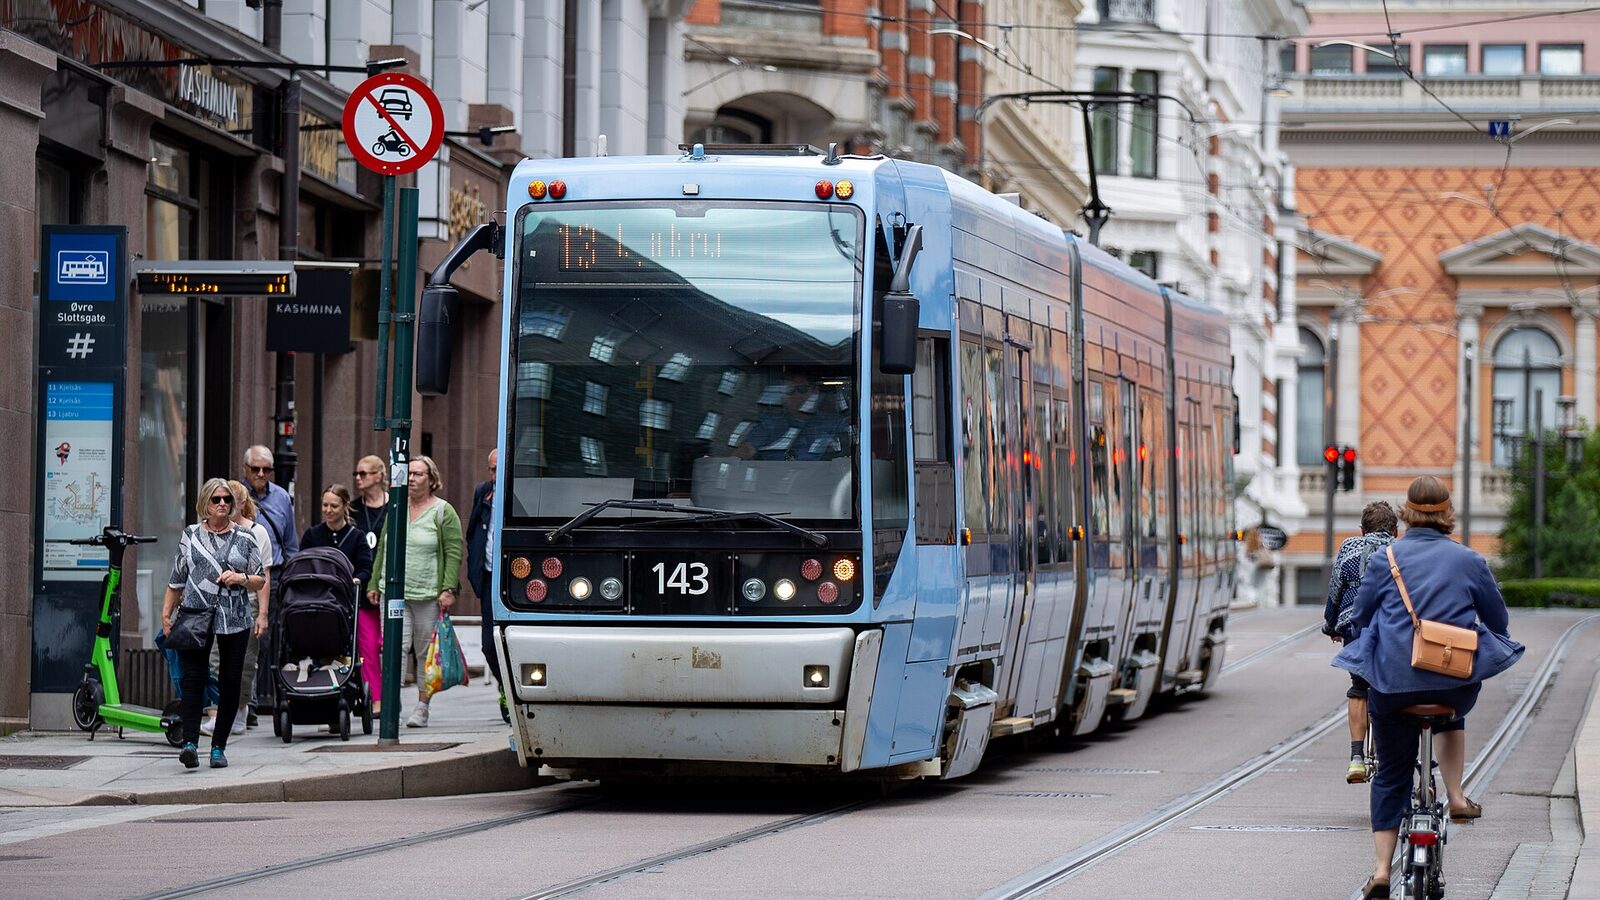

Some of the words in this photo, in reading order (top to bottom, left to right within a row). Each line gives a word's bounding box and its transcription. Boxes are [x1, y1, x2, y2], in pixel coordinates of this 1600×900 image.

[179, 63, 238, 128] KASHMINA
[559, 223, 596, 269] 13
[70, 302, 94, 312] Øvre
[276, 303, 342, 315] KASHMINA
[57, 312, 106, 325] Slottsgate
[48, 410, 56, 418] 13
[652, 562, 709, 595] 143
